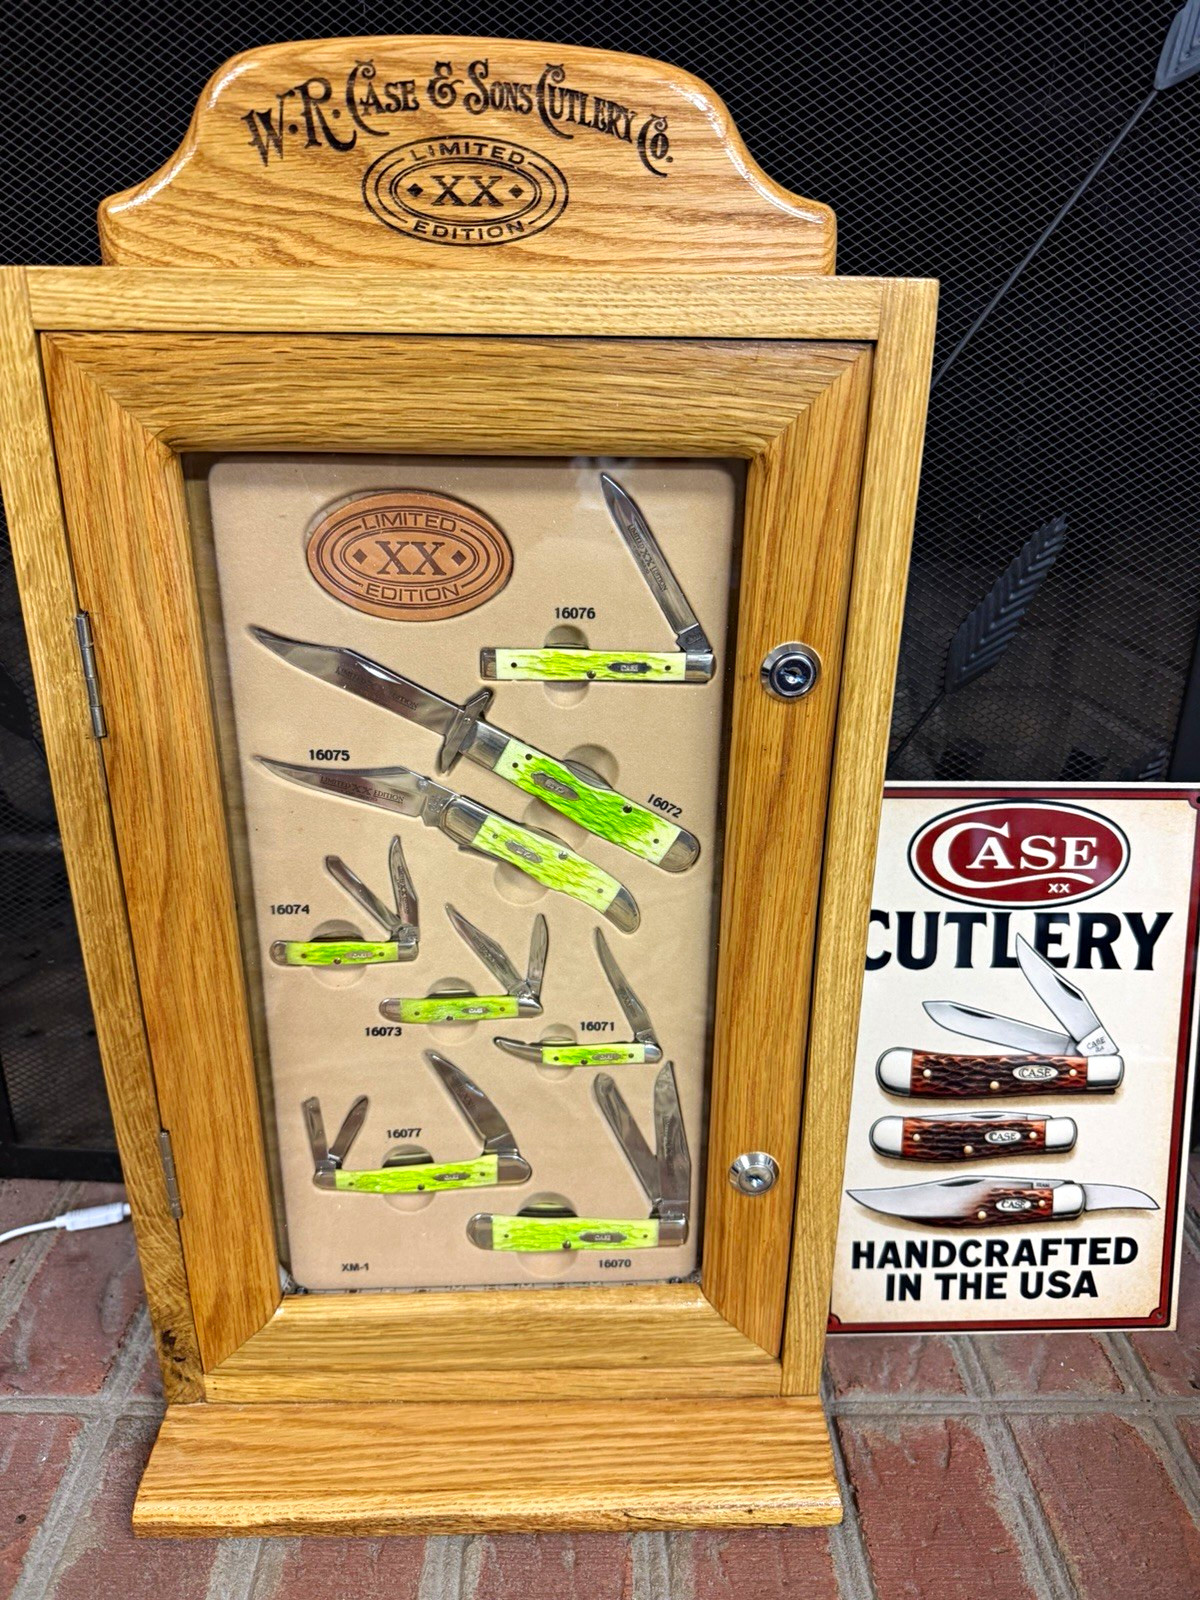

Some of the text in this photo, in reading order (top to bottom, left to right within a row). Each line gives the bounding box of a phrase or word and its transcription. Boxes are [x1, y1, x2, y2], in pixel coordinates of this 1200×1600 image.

[426, 60, 464, 108] &
[408, 141, 528, 166] LIMITED
[429, 174, 505, 208] XX
[412, 220, 526, 243] EDITION
[360, 512, 457, 533] LIMITED
[375, 540, 447, 576] XX
[365, 582, 460, 603] EDITION
[554, 607, 596, 620] 16076
[309, 748, 351, 762] 16075
[647, 793, 683, 819] 16072
[931, 821, 1098, 889] CASE
[270, 904, 310, 916] 16074
[864, 908, 1174, 972] CUTLERY
[364, 1026, 402, 1037] 16073
[579, 1021, 615, 1032] 16071
[1018, 1067, 1052, 1079] CASE
[386, 1127, 423, 1139] 16077
[989, 1131, 1017, 1142] CASE
[599, 1258, 632, 1269] 16070
[851, 1236, 1139, 1270] HANDCRAFTED
[341, 1262, 370, 1272] XM-1
[885, 1269, 1099, 1302] IN THE USA
